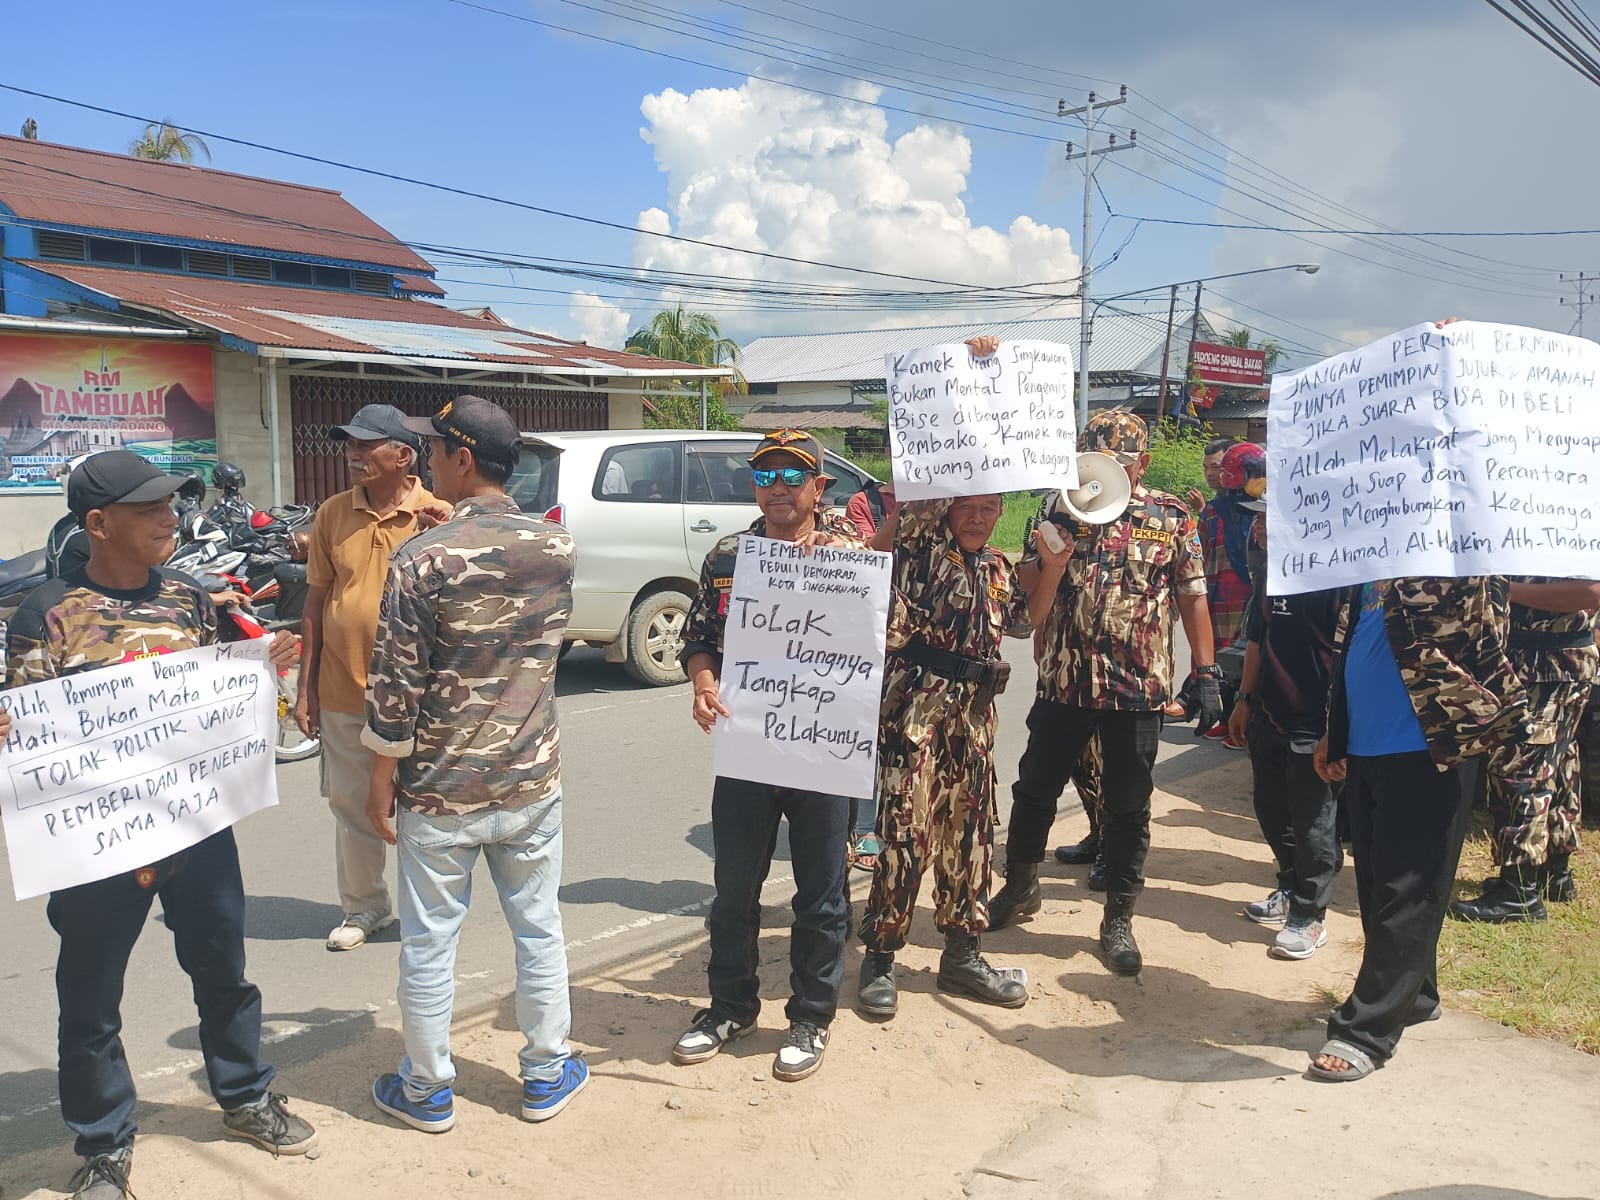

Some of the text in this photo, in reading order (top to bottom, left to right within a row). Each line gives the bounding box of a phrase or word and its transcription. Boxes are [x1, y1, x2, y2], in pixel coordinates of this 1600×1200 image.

[893, 352, 954, 379] Kamek
[1221, 354, 1243, 368] SAMBAL
[1244, 358, 1263, 370] BAKAR
[1286, 357, 1362, 401] JANGAN
[1392, 330, 1474, 362] PERNAH
[84, 370, 120, 386] RM
[1292, 390, 1345, 423] PUNYA
[1358, 362, 1439, 398] PEMIMPIN
[1455, 357, 1505, 380] JUJUR
[1526, 366, 1595, 393] AMANAH
[35, 382, 168, 416] TAMBUAH
[891, 384, 935, 406] Bukan
[42, 421, 165, 432] MASAKAN PADANG
[890, 408, 939, 430] Bise
[1029, 402, 1064, 421] Paka
[1302, 414, 1348, 447] JIKA
[1359, 398, 1416, 427] SUARA
[1432, 385, 1483, 410] BISA
[1001, 425, 1050, 445] Kamek
[11, 456, 61, 464] MENERIMA
[904, 458, 973, 485] Pejuang
[981, 455, 1011, 472] dan
[1421, 461, 1467, 484] dan
[1485, 458, 1588, 486] Perantara
[1133, 529, 1170, 541] FKPPI
[760, 560, 857, 581] PEDULI DEMOKRASI
[813, 549, 888, 569] MASYARAKAT
[768, 577, 795, 590] KOTA
[62, 674, 134, 706] Pemimpin
[153, 660, 199, 687] Dengan
[215, 646, 260, 661] Mata
[786, 640, 873, 685] Uangnya
[79, 707, 138, 737] Bukan
[149, 690, 200, 712] Mata
[23, 750, 107, 791] TOLAK
[114, 719, 187, 762] POLITIK
[147, 768, 177, 797] DAN
[189, 738, 267, 782] PENERIMA
[92, 787, 219, 855] SAMA SAJA
